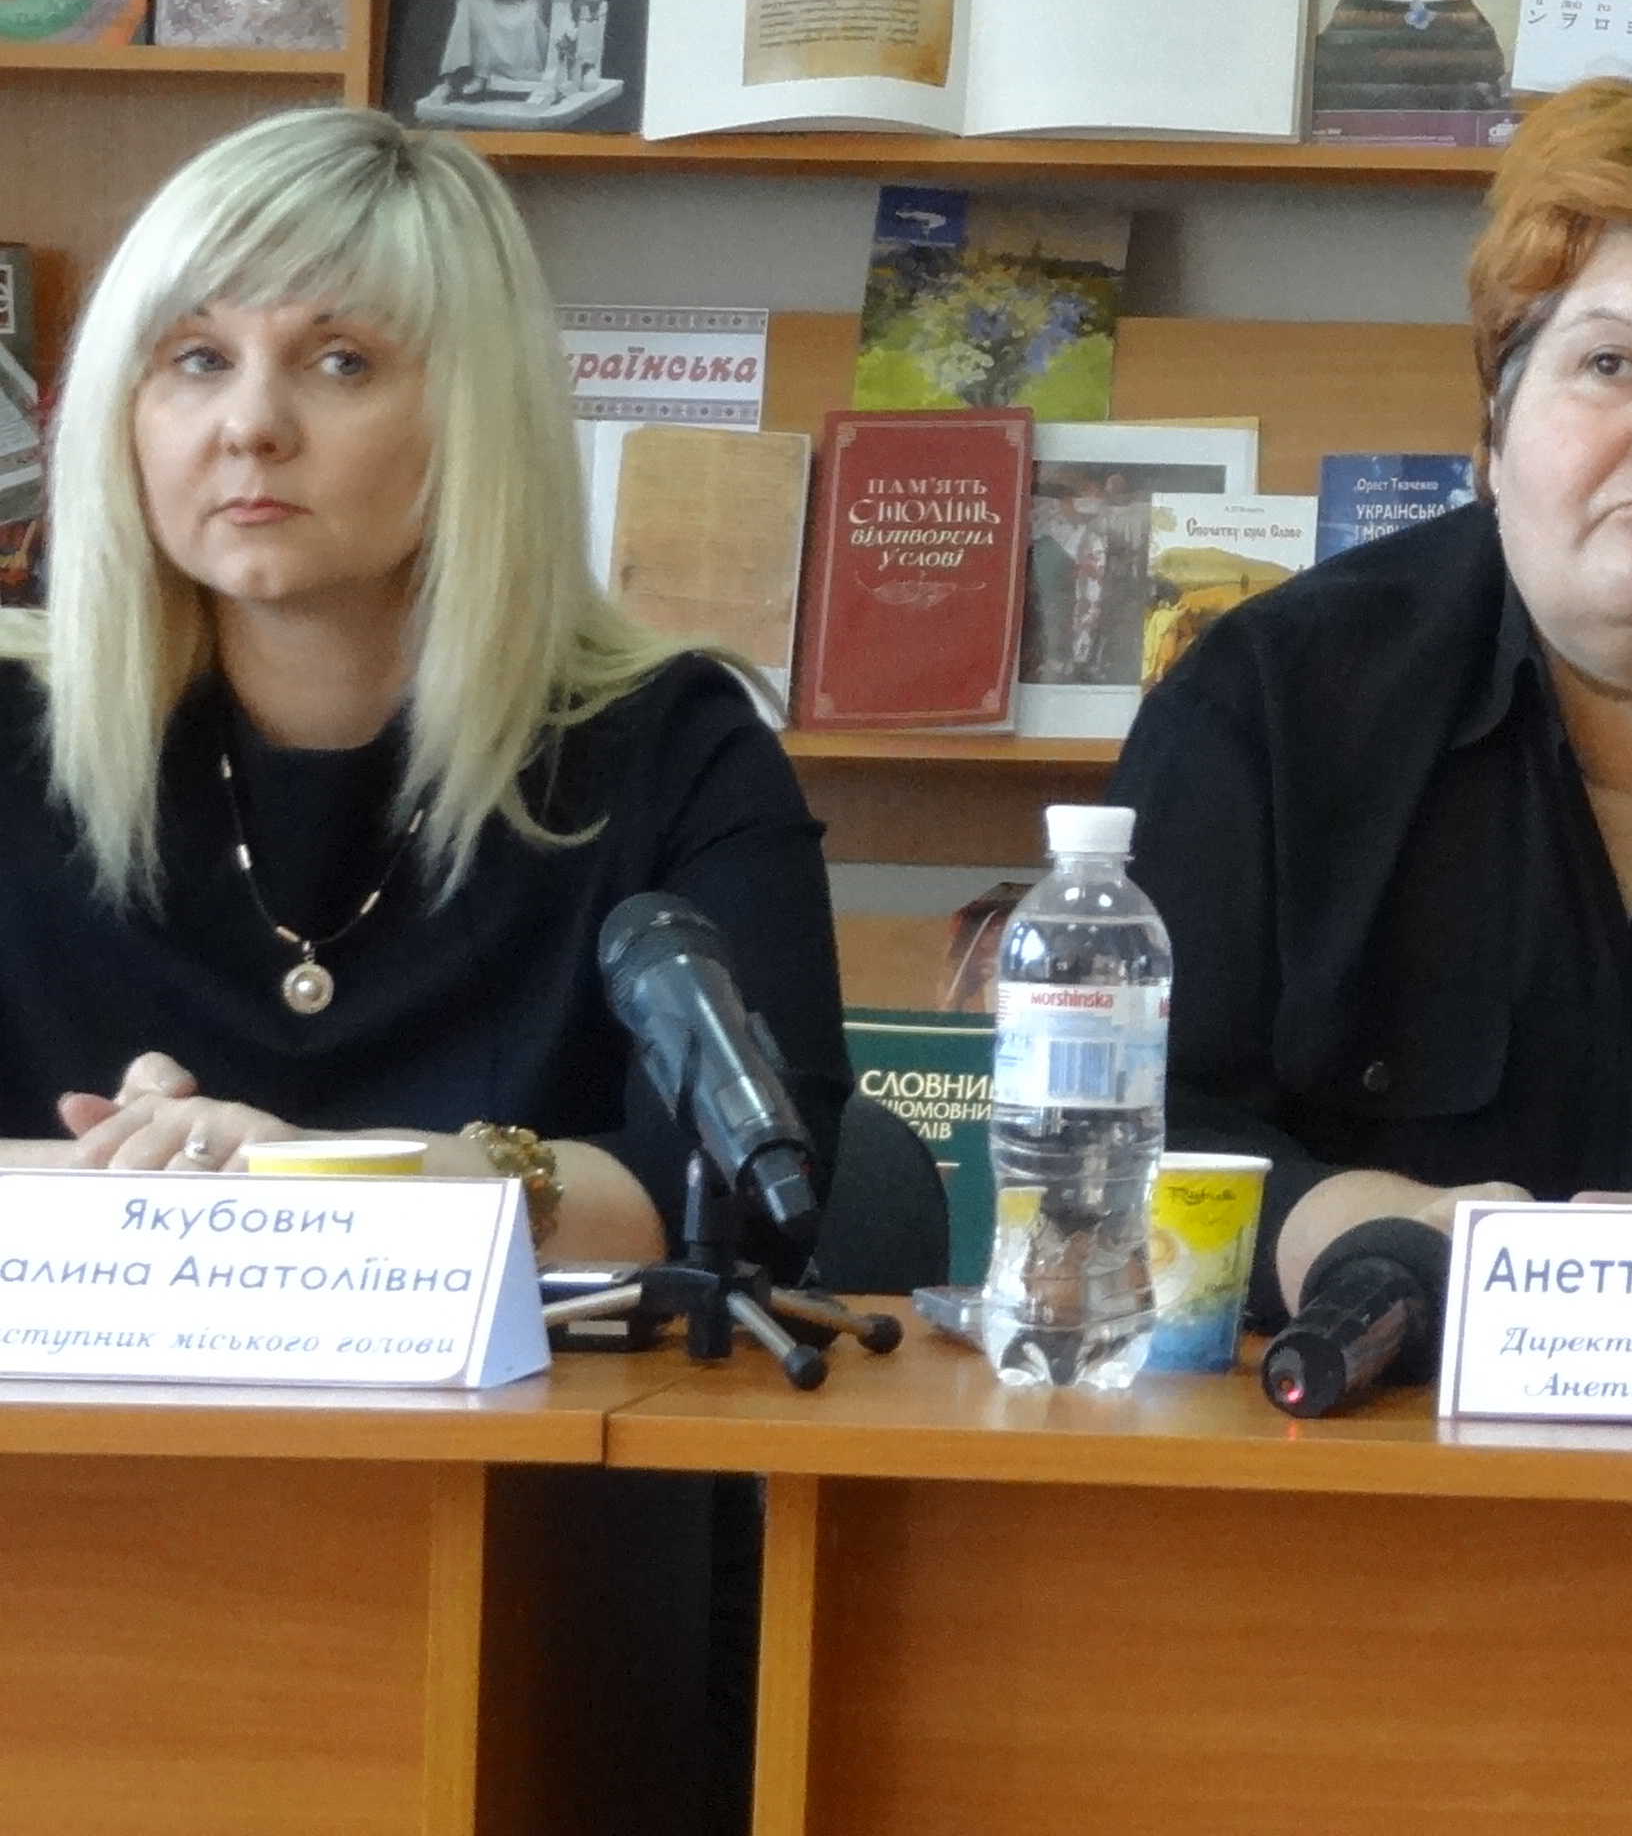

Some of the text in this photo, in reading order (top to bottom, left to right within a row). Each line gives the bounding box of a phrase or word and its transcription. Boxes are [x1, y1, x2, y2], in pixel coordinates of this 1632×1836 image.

[1356, 478, 1439, 494] Орест Ткаченко
[120, 1197, 357, 1241] Якубович
[169, 1254, 473, 1295] Анатоліївна
[169, 1326, 321, 1356] міського
[334, 1331, 456, 1356] голови
